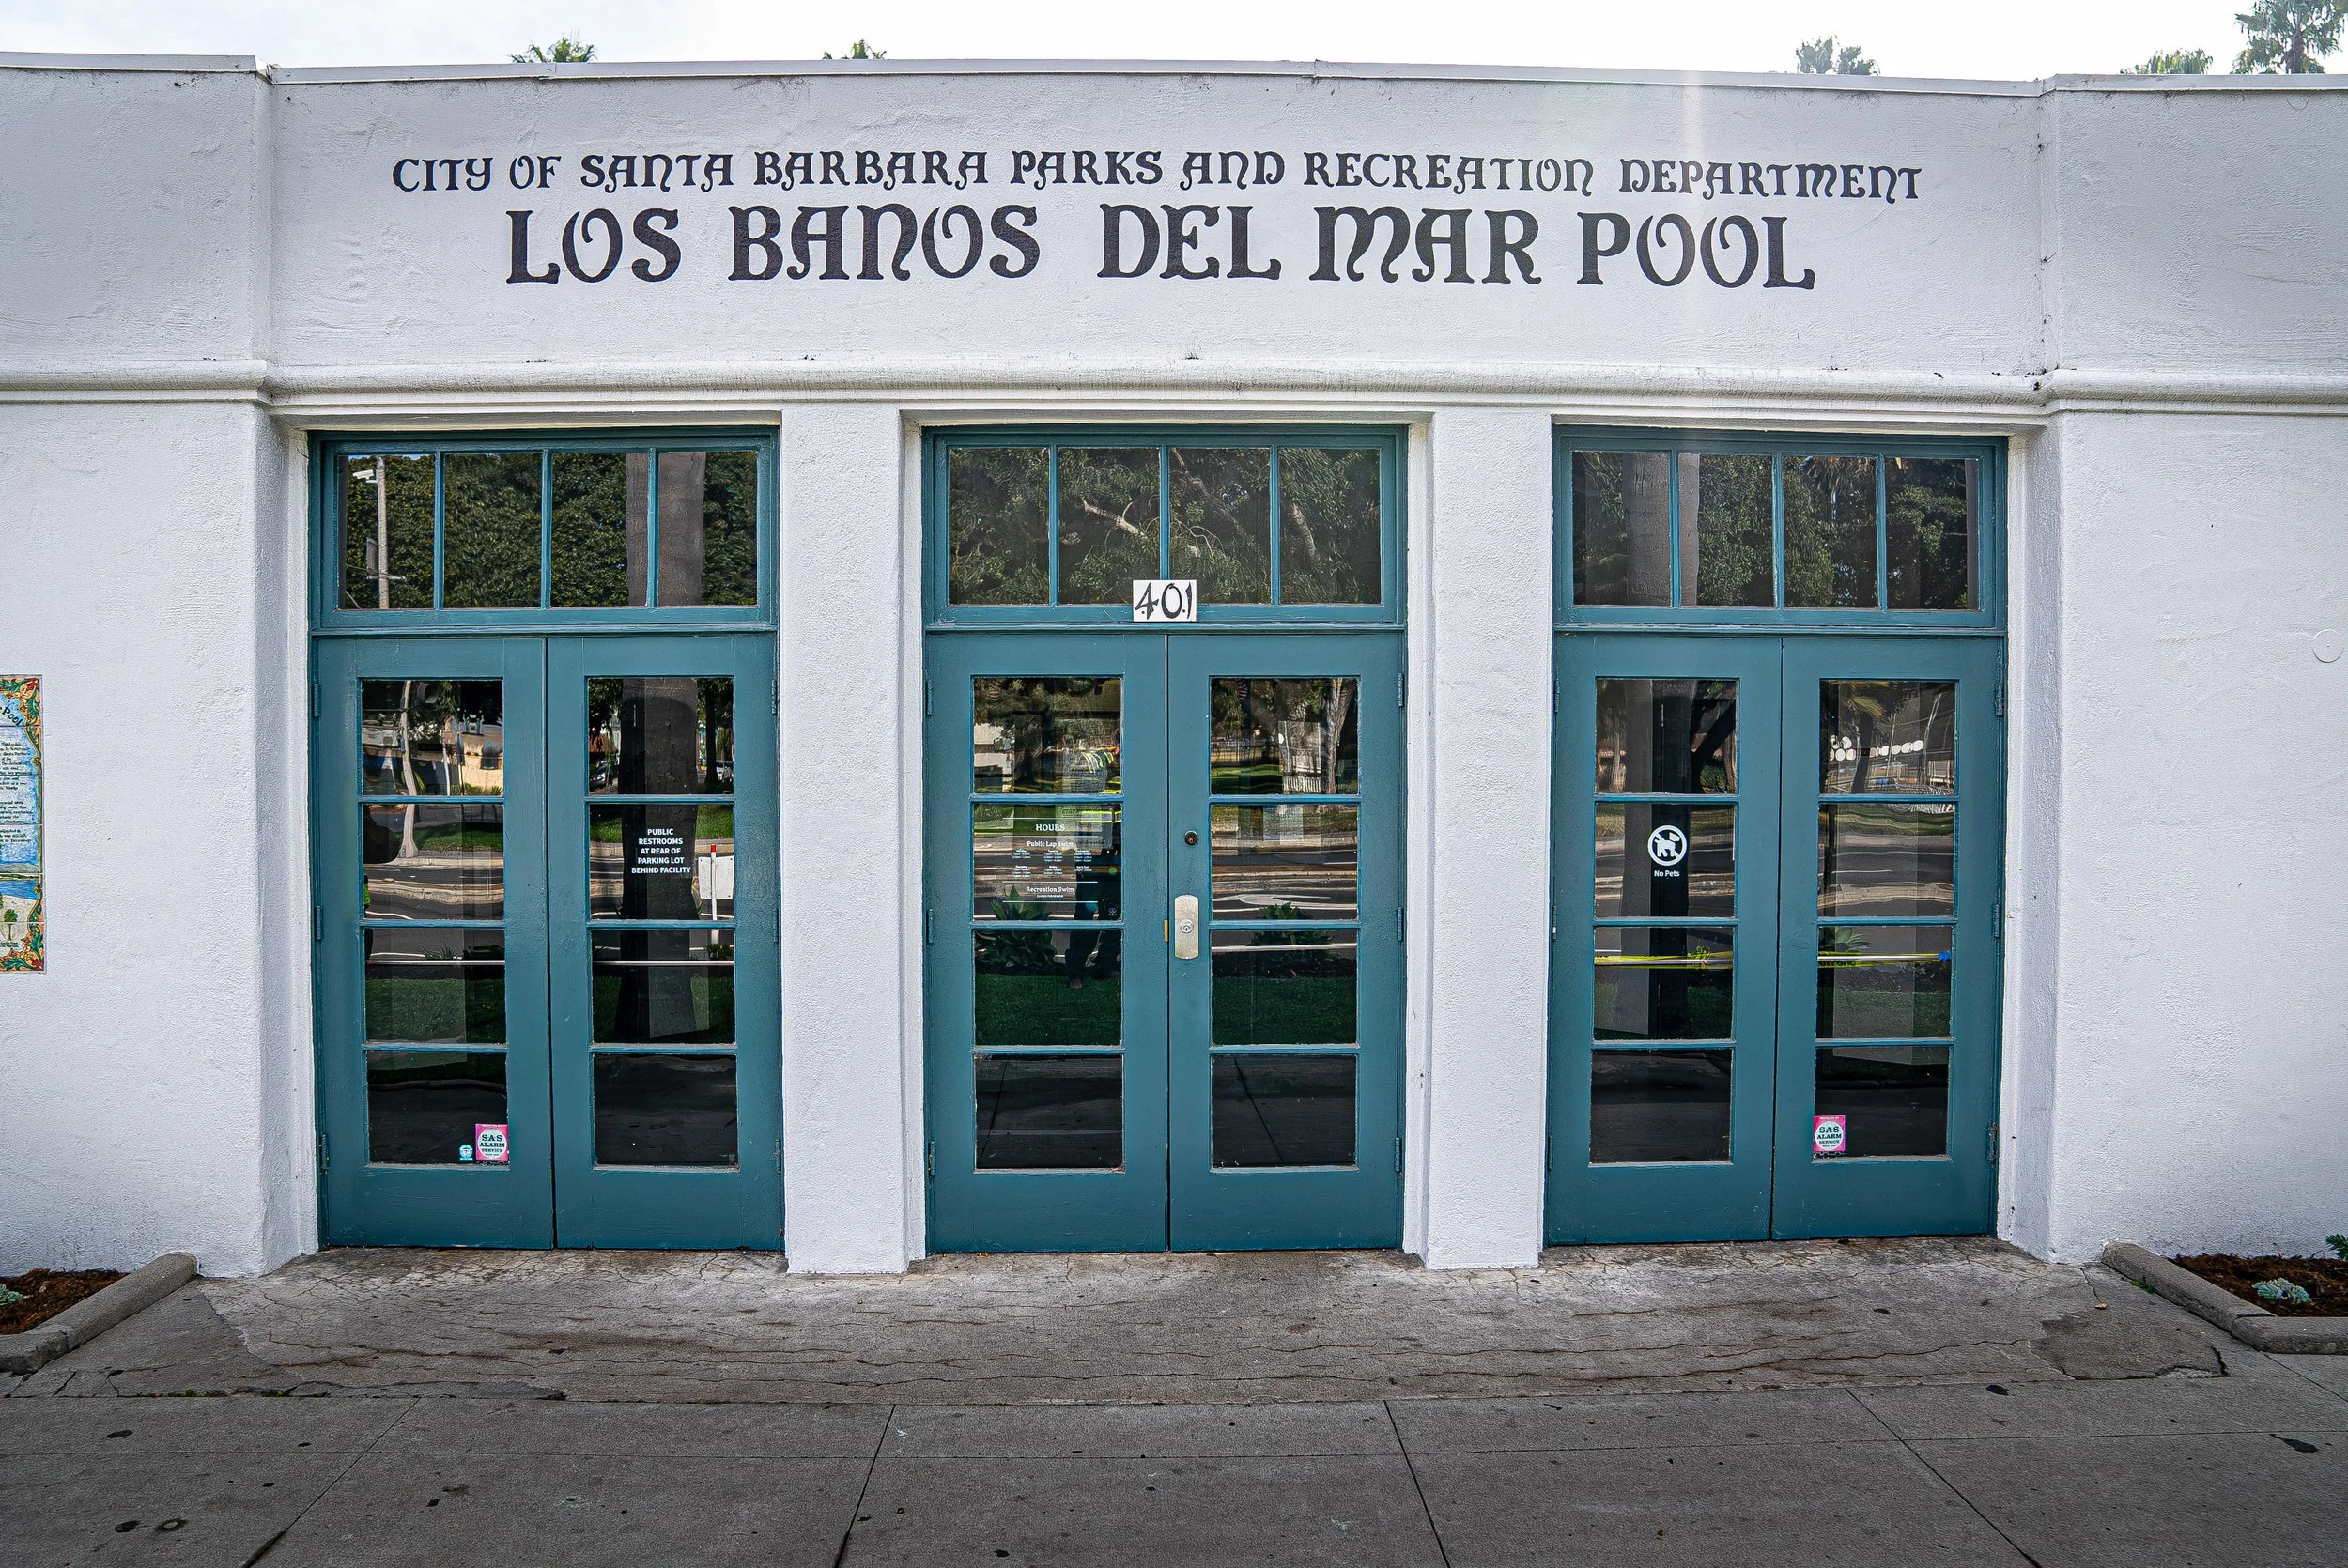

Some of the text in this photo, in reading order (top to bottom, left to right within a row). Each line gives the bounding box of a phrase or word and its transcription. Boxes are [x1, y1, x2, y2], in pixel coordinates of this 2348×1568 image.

[393, 151, 1923, 204] CITY OF SANTA BARBARA PARKS AND RECREATION DEPARTMENT
[506, 204, 1816, 290] LOS BANOS DEL MAR POOL
[1135, 581, 1193, 621] 401
[2, 706, 24, 727] Pool
[1035, 823, 1066, 832] HOURS
[637, 856, 669, 865] PARKING
